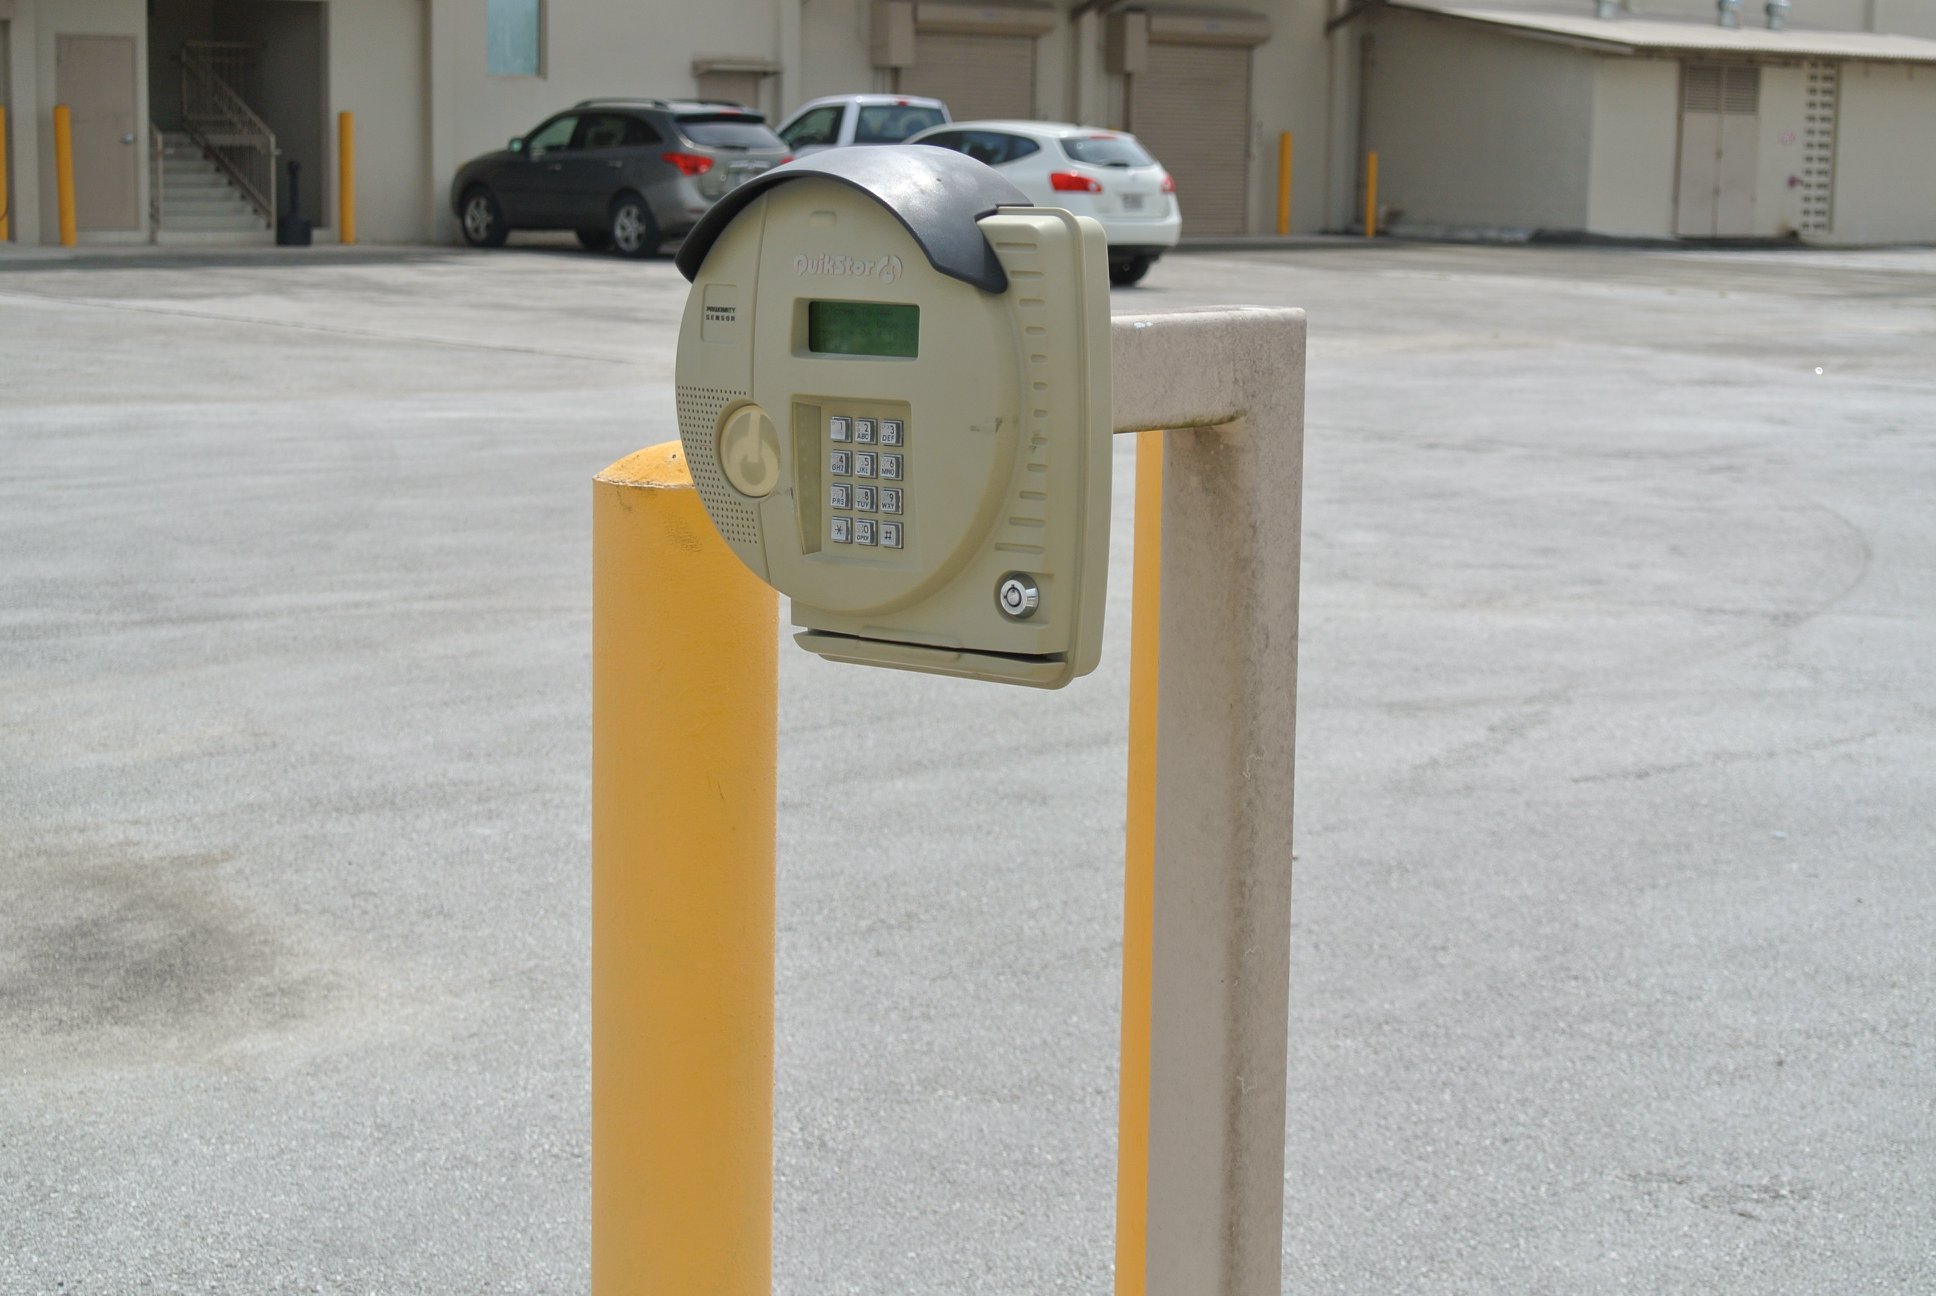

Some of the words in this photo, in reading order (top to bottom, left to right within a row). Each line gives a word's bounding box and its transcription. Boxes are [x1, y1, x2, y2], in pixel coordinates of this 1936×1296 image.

[793, 253, 876, 277] QuikStor
[706, 314, 736, 322] SENSOR
[864, 423, 869, 433] 2
[890, 425, 895, 435] 3
[857, 432, 869, 440] ABC
[882, 434, 895, 442] DEF
[864, 457, 869, 467] 5
[857, 466, 869, 475] JKL
[881, 468, 894, 476] MNO
[864, 491, 869, 500] 8
[881, 502, 895, 510] WXY
[863, 525, 869, 534] 0
